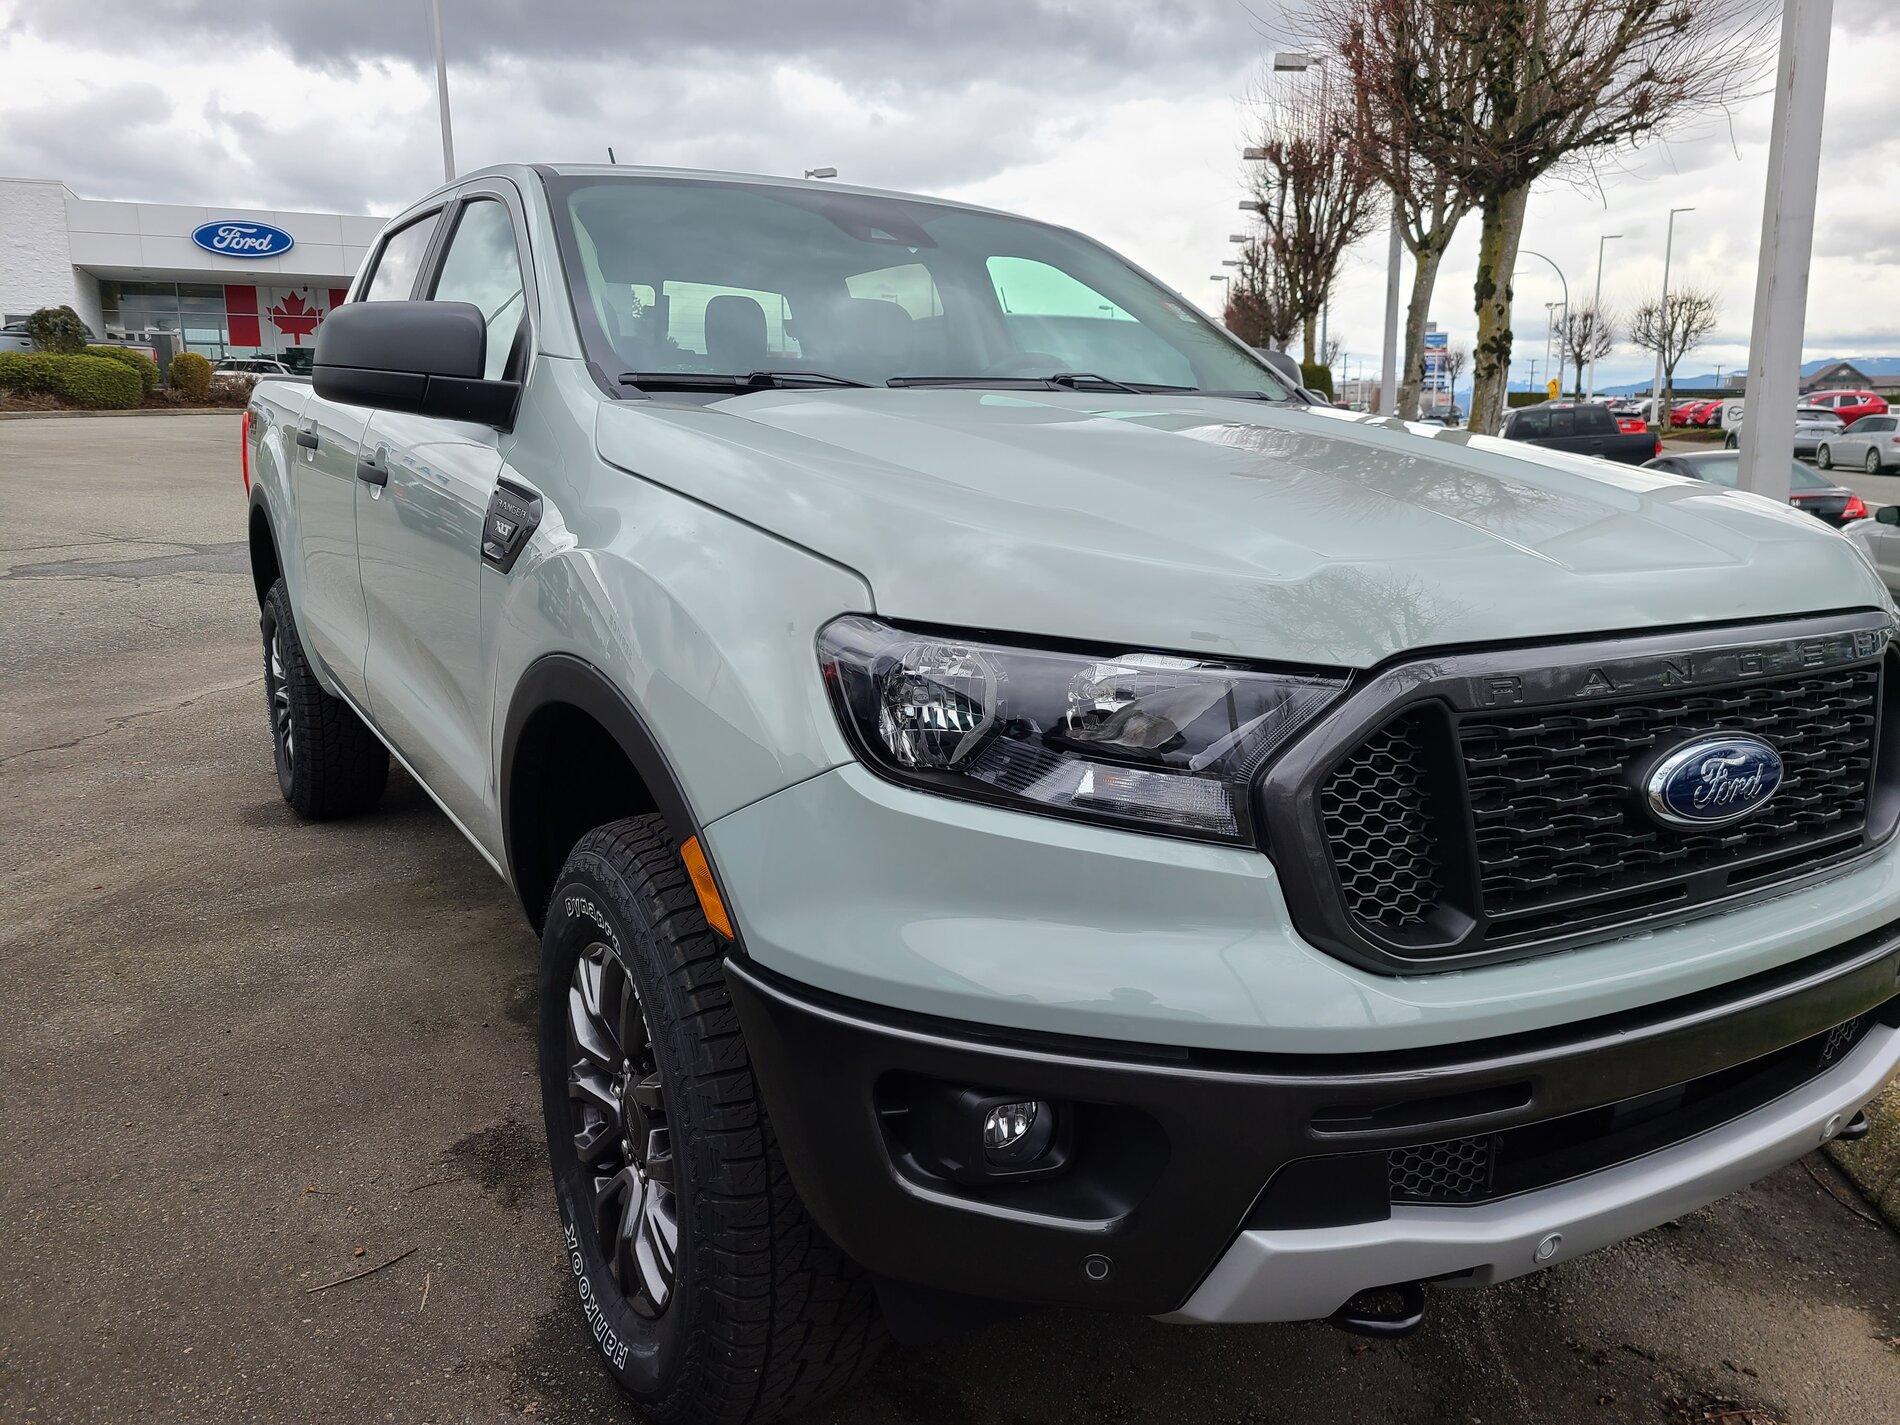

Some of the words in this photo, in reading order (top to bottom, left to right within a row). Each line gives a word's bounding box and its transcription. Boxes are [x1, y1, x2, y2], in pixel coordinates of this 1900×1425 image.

[213, 226, 273, 251] Ford
[497, 498, 527, 519] RANGER
[495, 520, 512, 536] XLT
[1482, 631, 1877, 706] RANGER
[1693, 754, 1764, 809] Ford
